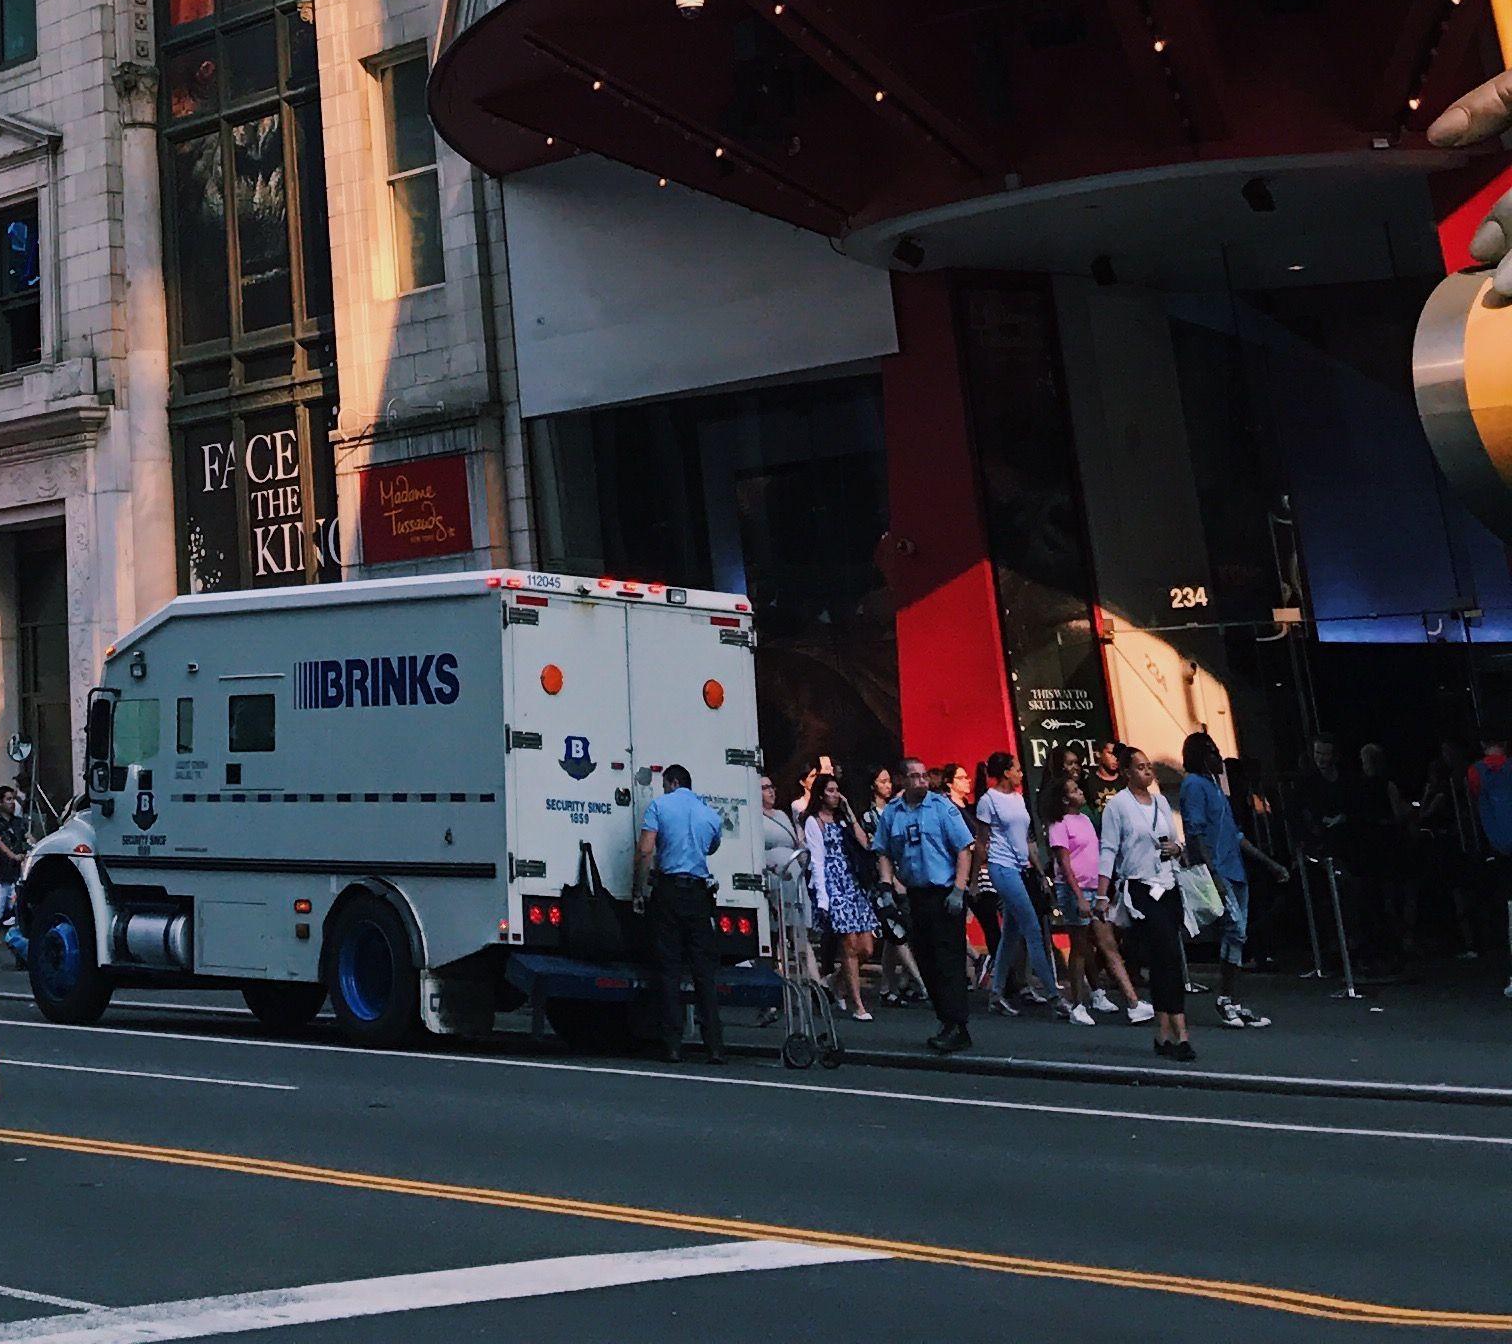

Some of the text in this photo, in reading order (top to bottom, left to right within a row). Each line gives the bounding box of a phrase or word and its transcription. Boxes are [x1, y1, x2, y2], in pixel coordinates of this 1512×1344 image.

[201, 429, 300, 494] FACE
[379, 474, 437, 508] Madame
[250, 484, 302, 521] THE
[383, 501, 448, 542] Tussauds
[526, 574, 561, 589] 112045
[1170, 586, 1209, 609] 234
[320, 652, 461, 710] BRINKS
[1029, 688, 1089, 700] THIS WAY TO
[1028, 700, 1094, 711] SKULL ISLAND
[571, 739, 585, 758] B
[545, 798, 612, 815] SECURITY SINCE
[569, 813, 590, 825] 1859
[121, 834, 167, 846] SECURITY SINCE
